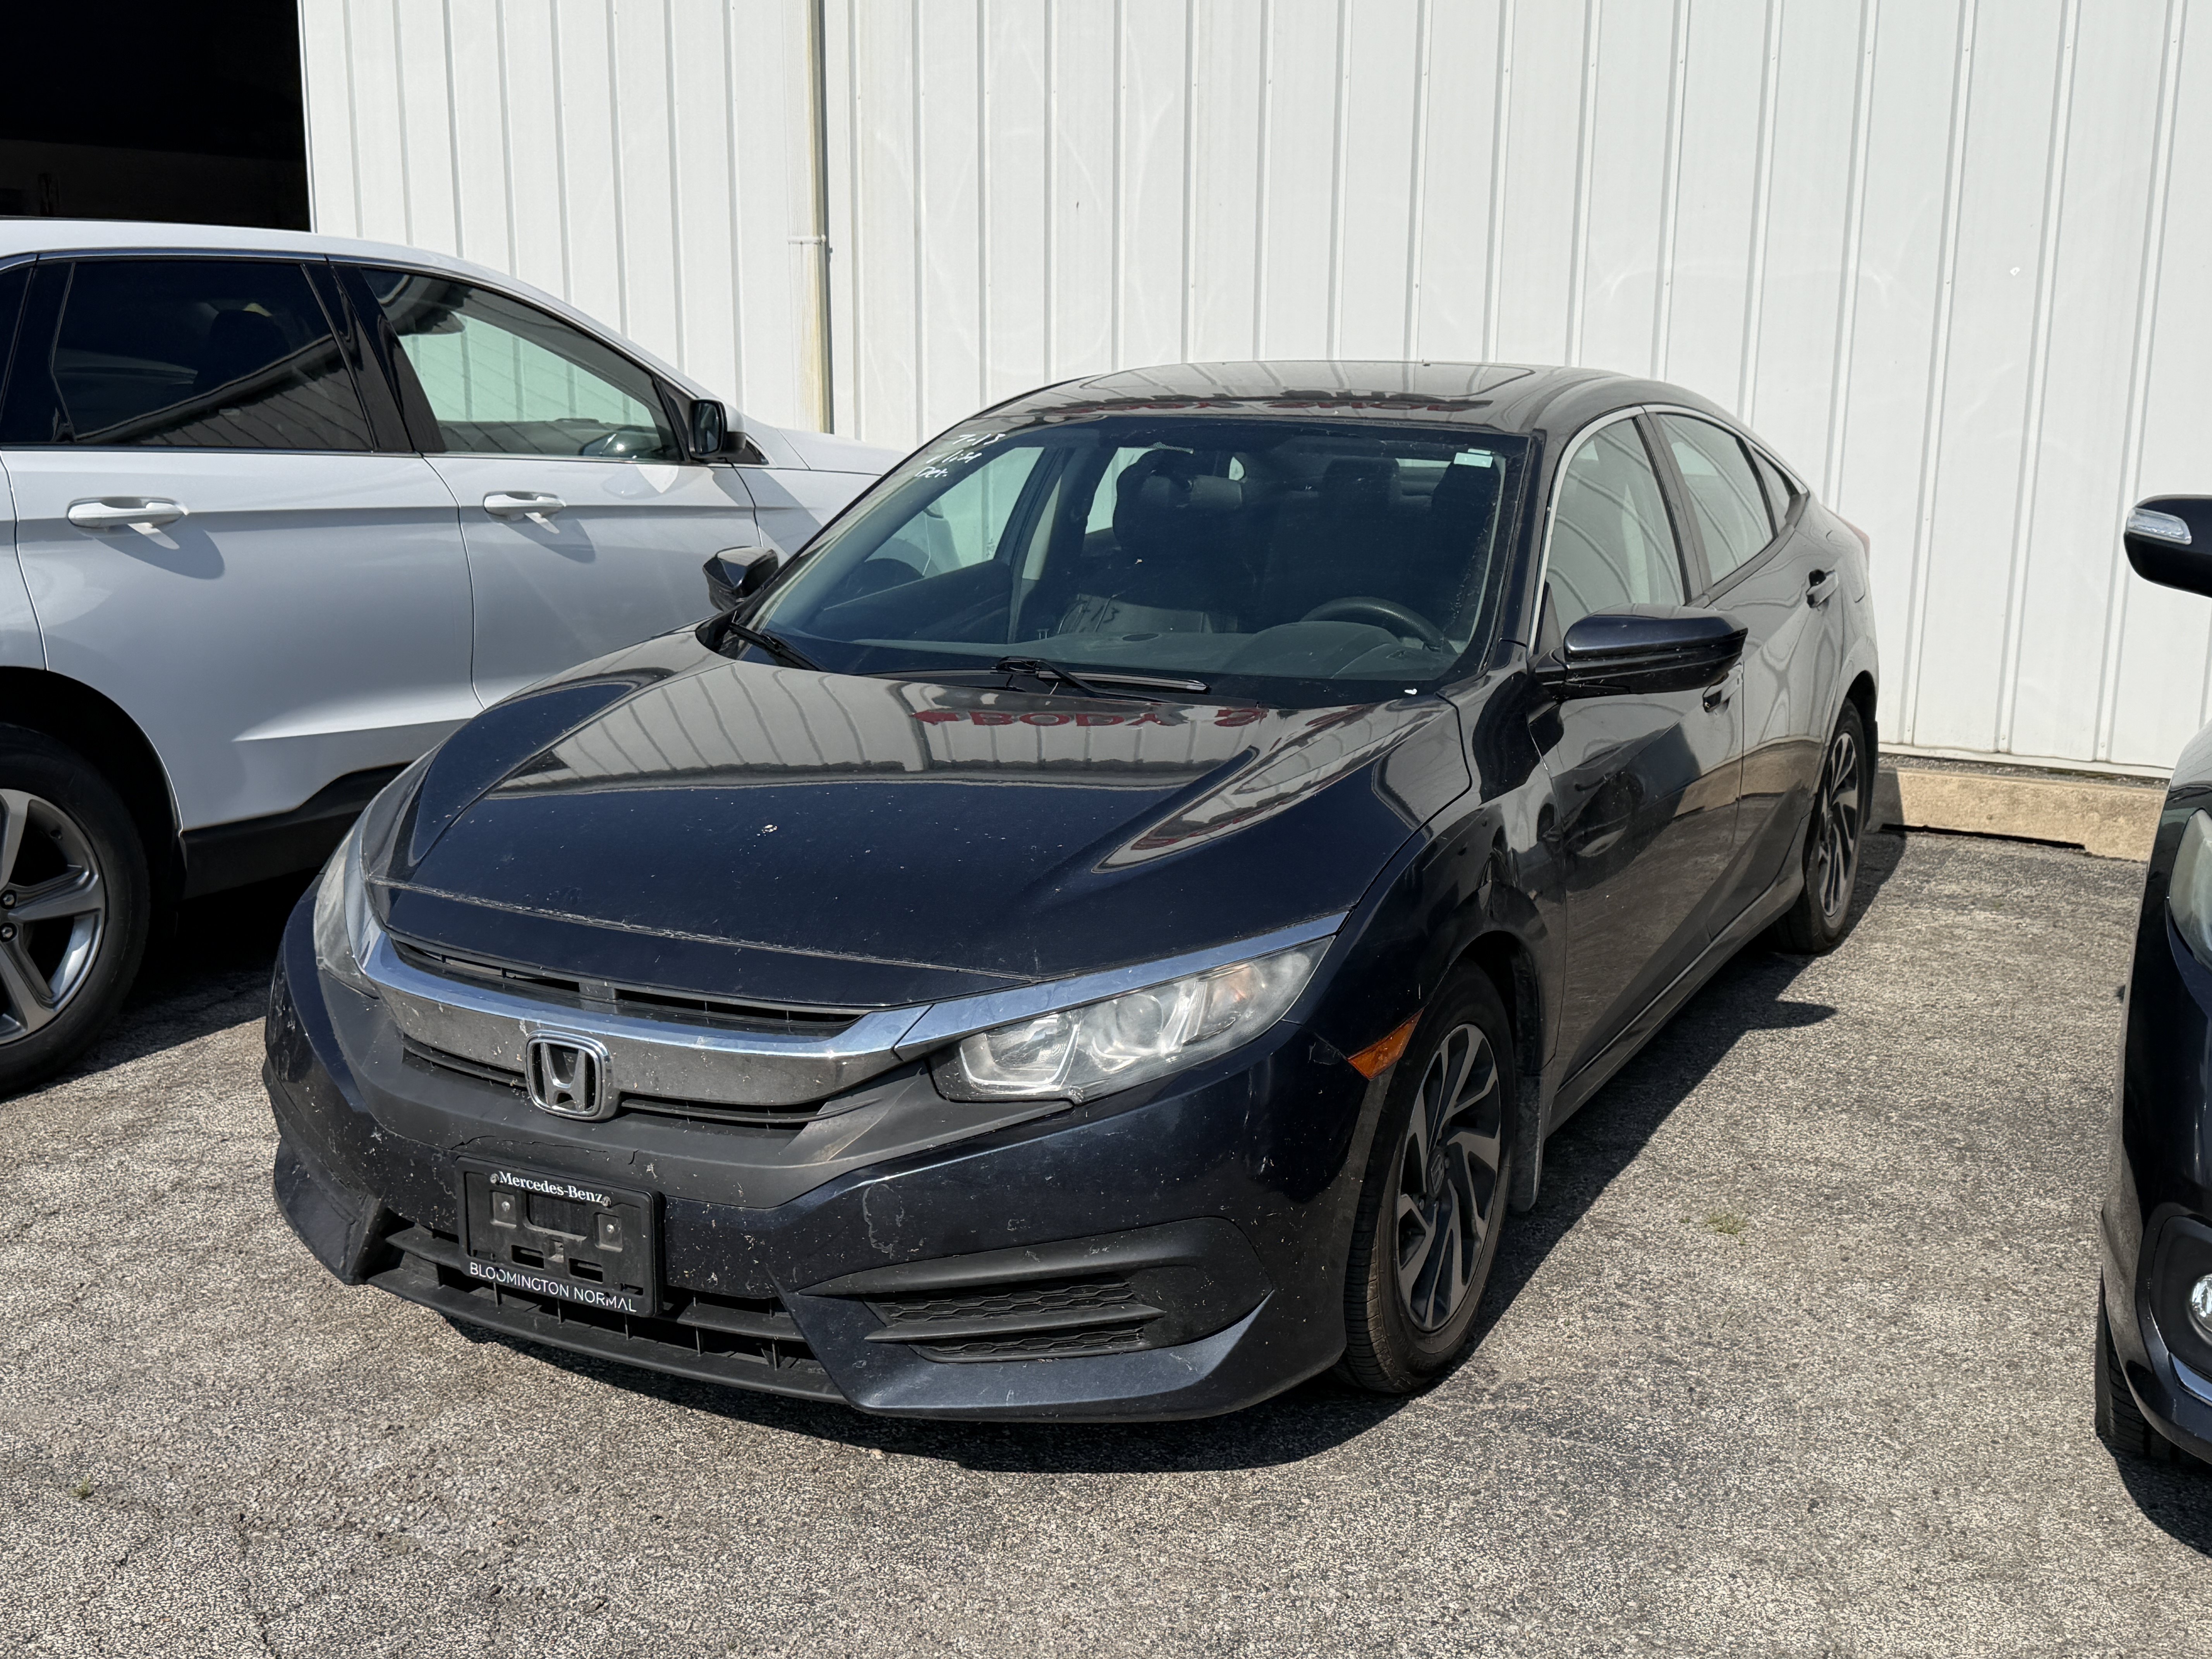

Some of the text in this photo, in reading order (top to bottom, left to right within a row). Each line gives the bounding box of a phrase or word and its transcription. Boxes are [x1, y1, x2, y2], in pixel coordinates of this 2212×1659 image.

[499, 1170, 603, 1204] Mercedes-Benz
[470, 1262, 637, 1313] BLOOMINGTON NORMAL
